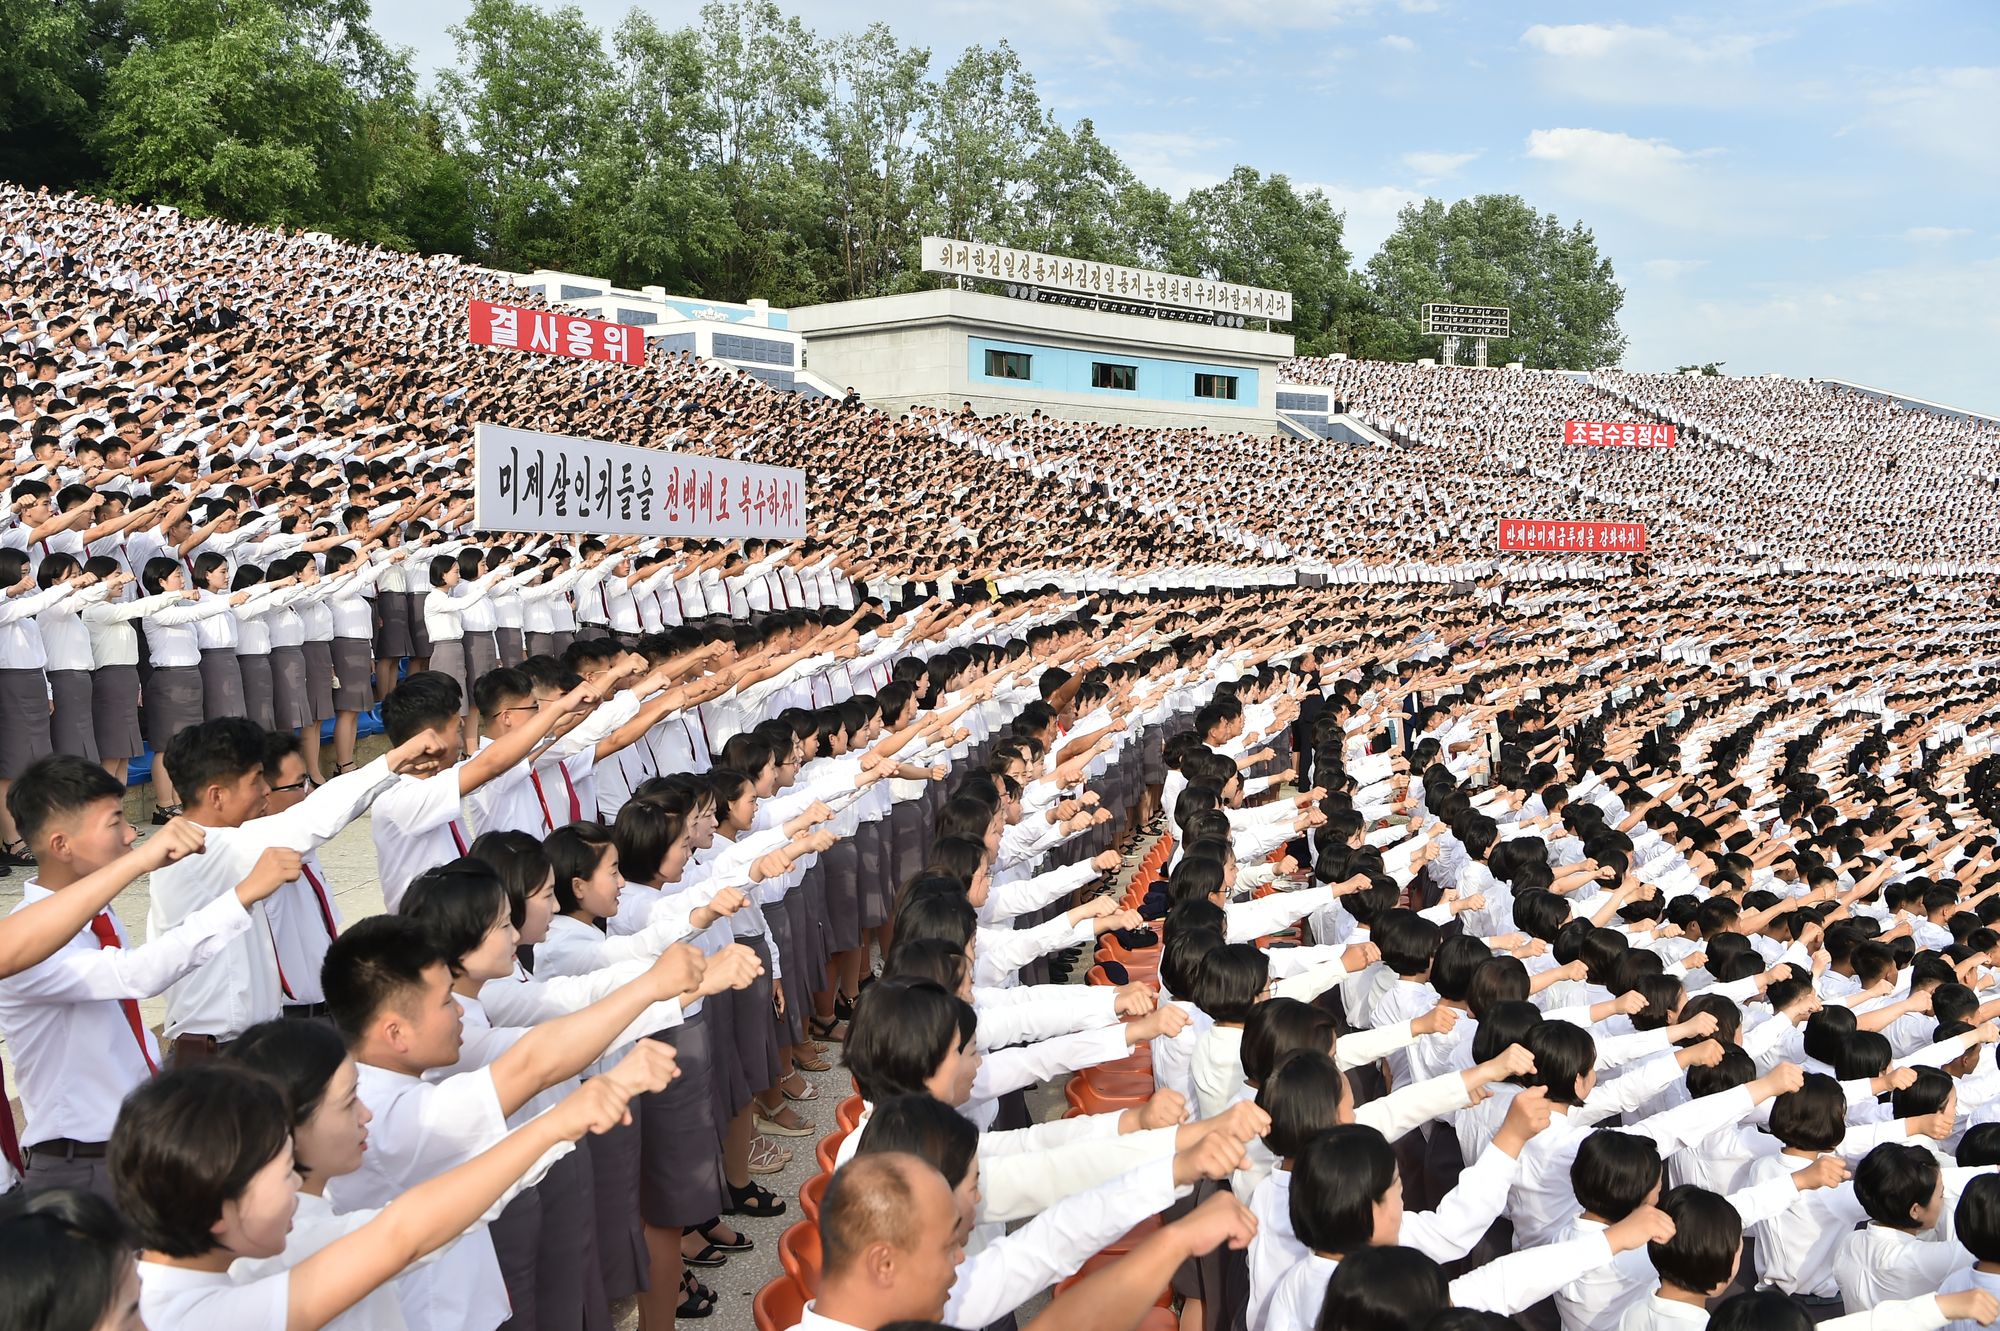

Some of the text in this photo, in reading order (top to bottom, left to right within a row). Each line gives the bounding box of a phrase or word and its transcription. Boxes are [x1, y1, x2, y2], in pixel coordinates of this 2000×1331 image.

[490, 307, 628, 362] 결사옹위
[1572, 423, 1668, 446] 조국수호정신
[498, 447, 799, 527] 미제살인귀들을 천백배로 복수하자!
[1598, 526, 1641, 548] 강화하자!
